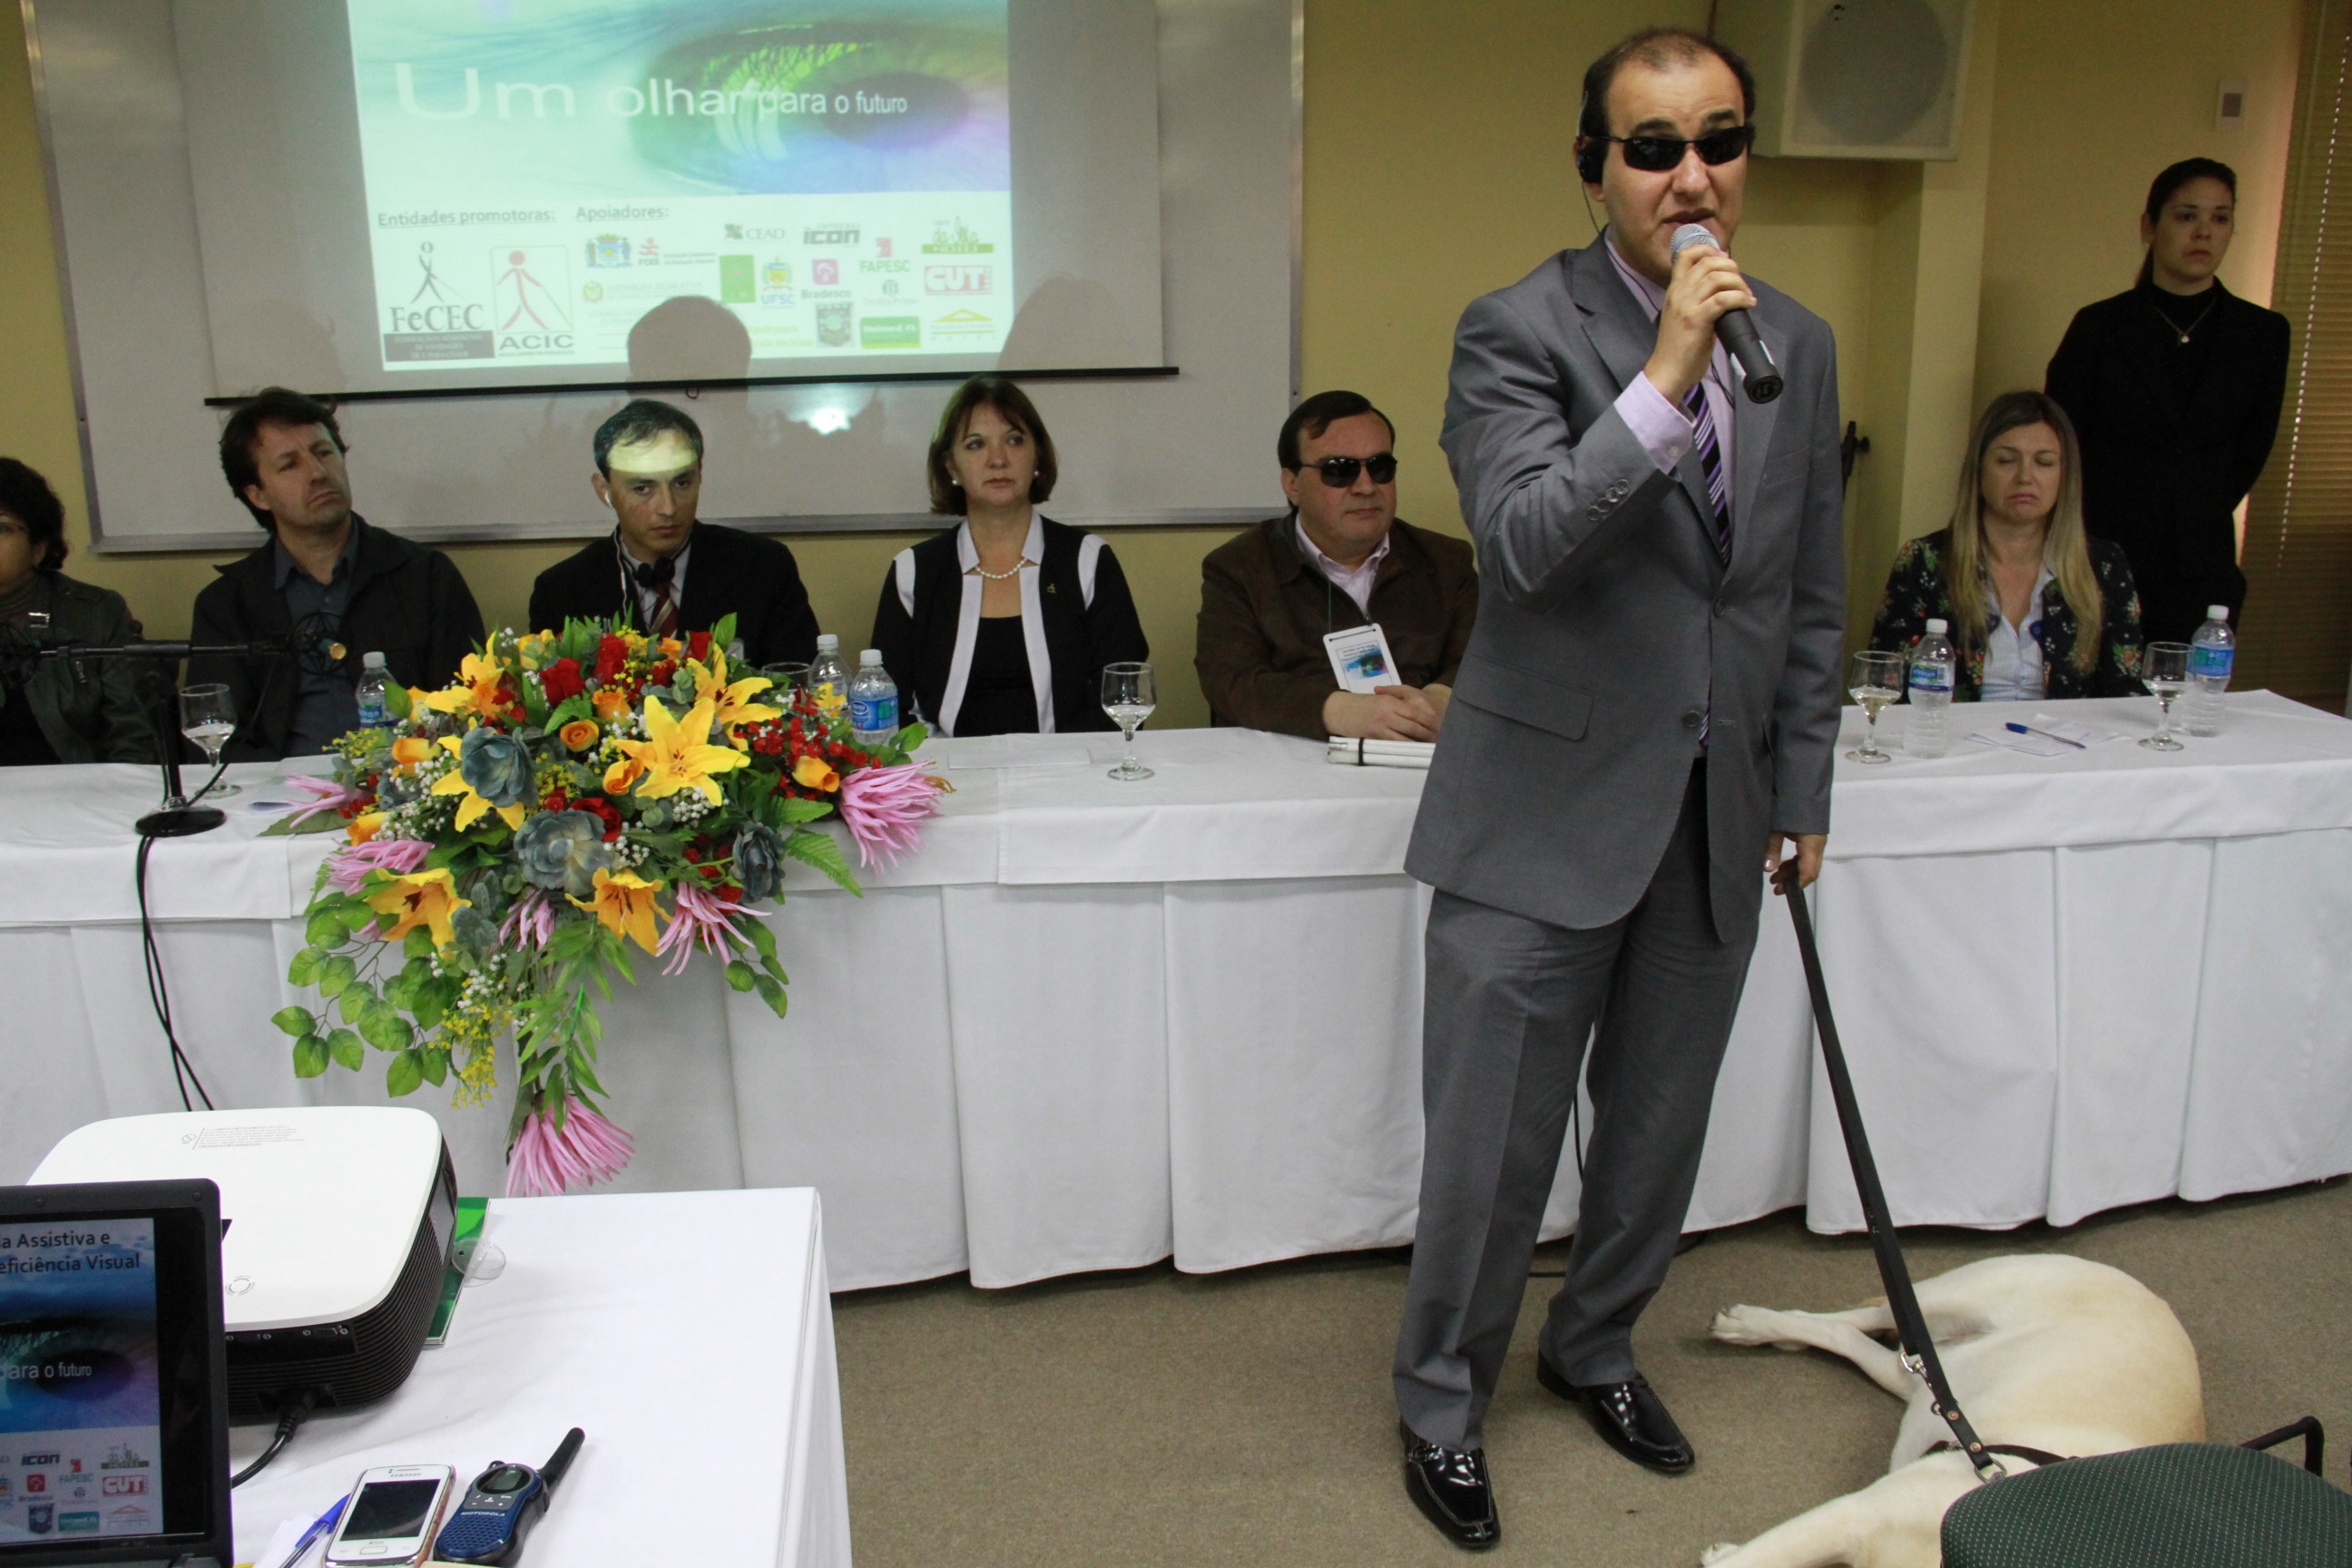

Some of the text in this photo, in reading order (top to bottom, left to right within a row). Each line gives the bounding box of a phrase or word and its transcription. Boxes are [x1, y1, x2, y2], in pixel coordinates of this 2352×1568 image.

[395, 62, 907, 121] Um olhar para o futuro
[377, 210, 556, 227] Entidades promotoras:
[575, 207, 670, 223] Apoiadores:
[746, 227, 786, 240] CEAD
[802, 227, 860, 246] icon
[859, 260, 910, 274] FAPESC
[926, 267, 984, 292] CUT
[760, 294, 795, 307] UFSC
[800, 289, 851, 300] Bradesco
[390, 304, 485, 332] FeCEC
[498, 335, 574, 351] ACIC
[16, 1230, 96, 1248] Assistiva
[100, 1233, 111, 1245] e
[86, 1252, 140, 1269] Visual
[44, 1365, 54, 1377] o
[58, 1360, 92, 1377] futuro
[21, 1452, 60, 1466] icon
[104, 1475, 145, 1494] CUT
